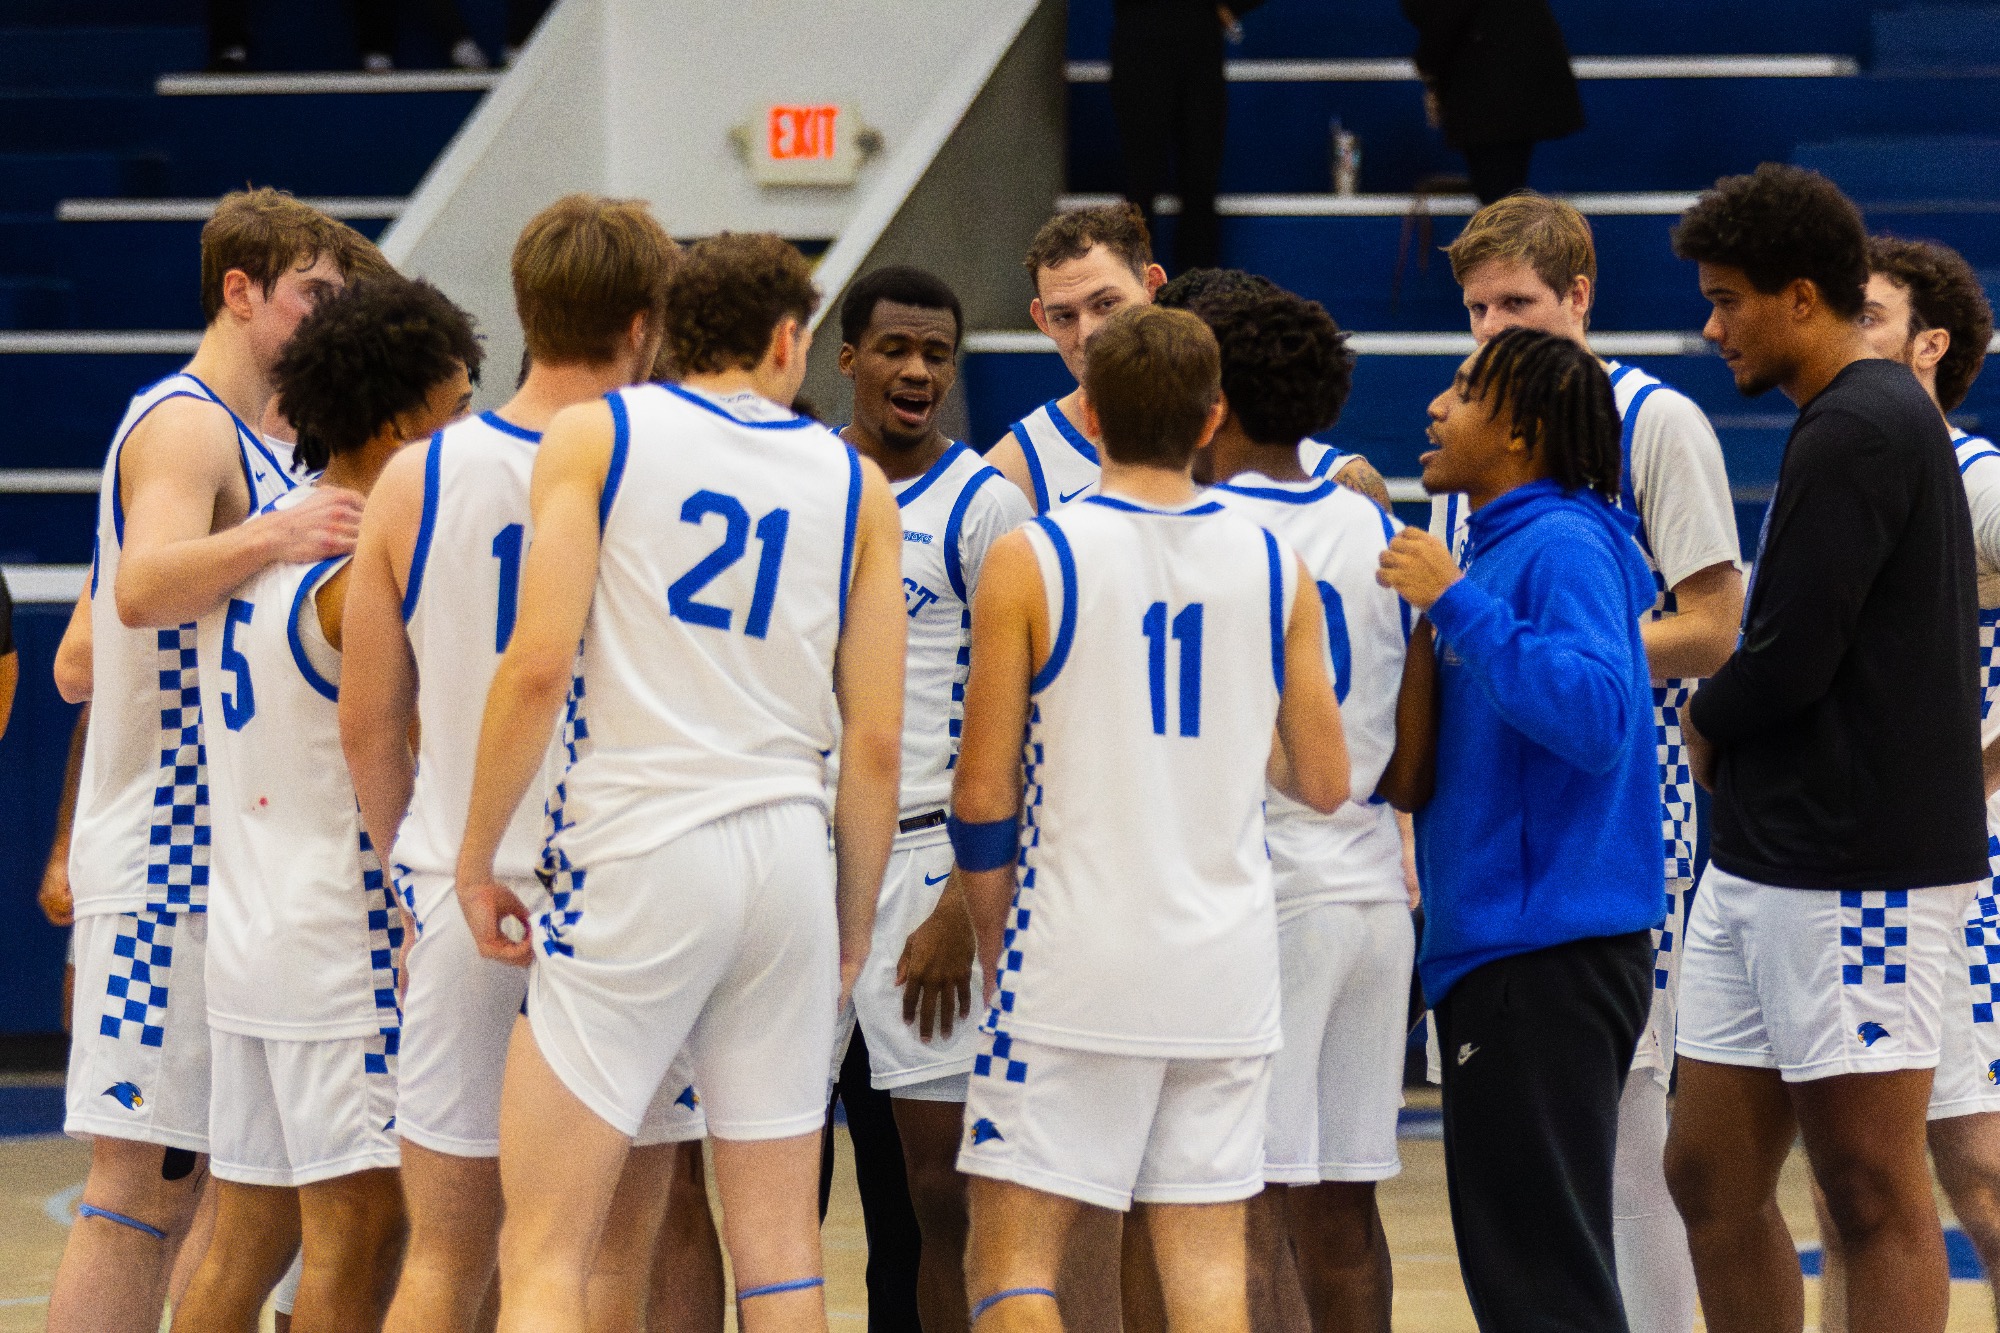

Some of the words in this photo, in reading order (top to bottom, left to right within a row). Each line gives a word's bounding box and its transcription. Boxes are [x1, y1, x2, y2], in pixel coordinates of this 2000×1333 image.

[768, 104, 838, 160] EXIT
[491, 522, 532, 654] 1
[667, 488, 791, 641] 21
[220, 598, 256, 733] 5
[1142, 601, 1203, 738] 11
